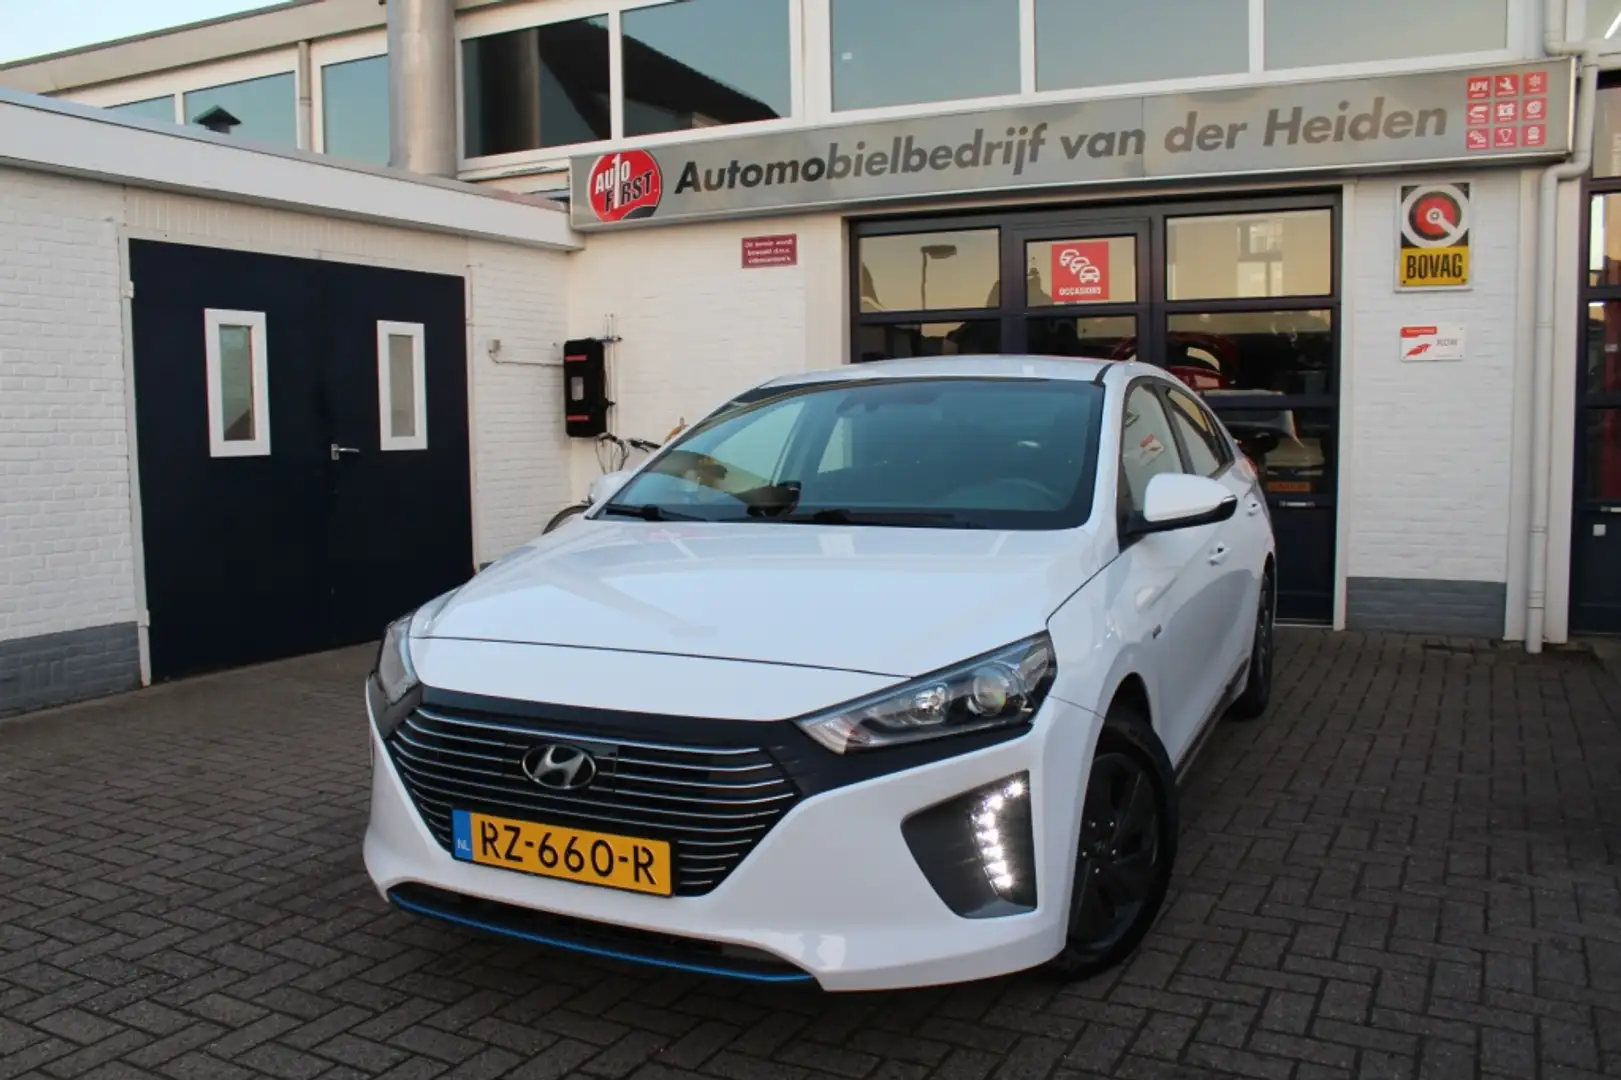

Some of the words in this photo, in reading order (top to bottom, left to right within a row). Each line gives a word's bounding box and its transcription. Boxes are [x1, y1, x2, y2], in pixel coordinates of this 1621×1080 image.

[675, 122, 1049, 194] Automobielbedrijf
[1059, 128, 1145, 160] van
[1163, 110, 1248, 154] der
[1263, 96, 1447, 147] Heiden
[1406, 253, 1463, 280] BOVAG
[456, 838, 471, 852] NL
[480, 820, 657, 886] RZ-660-R
